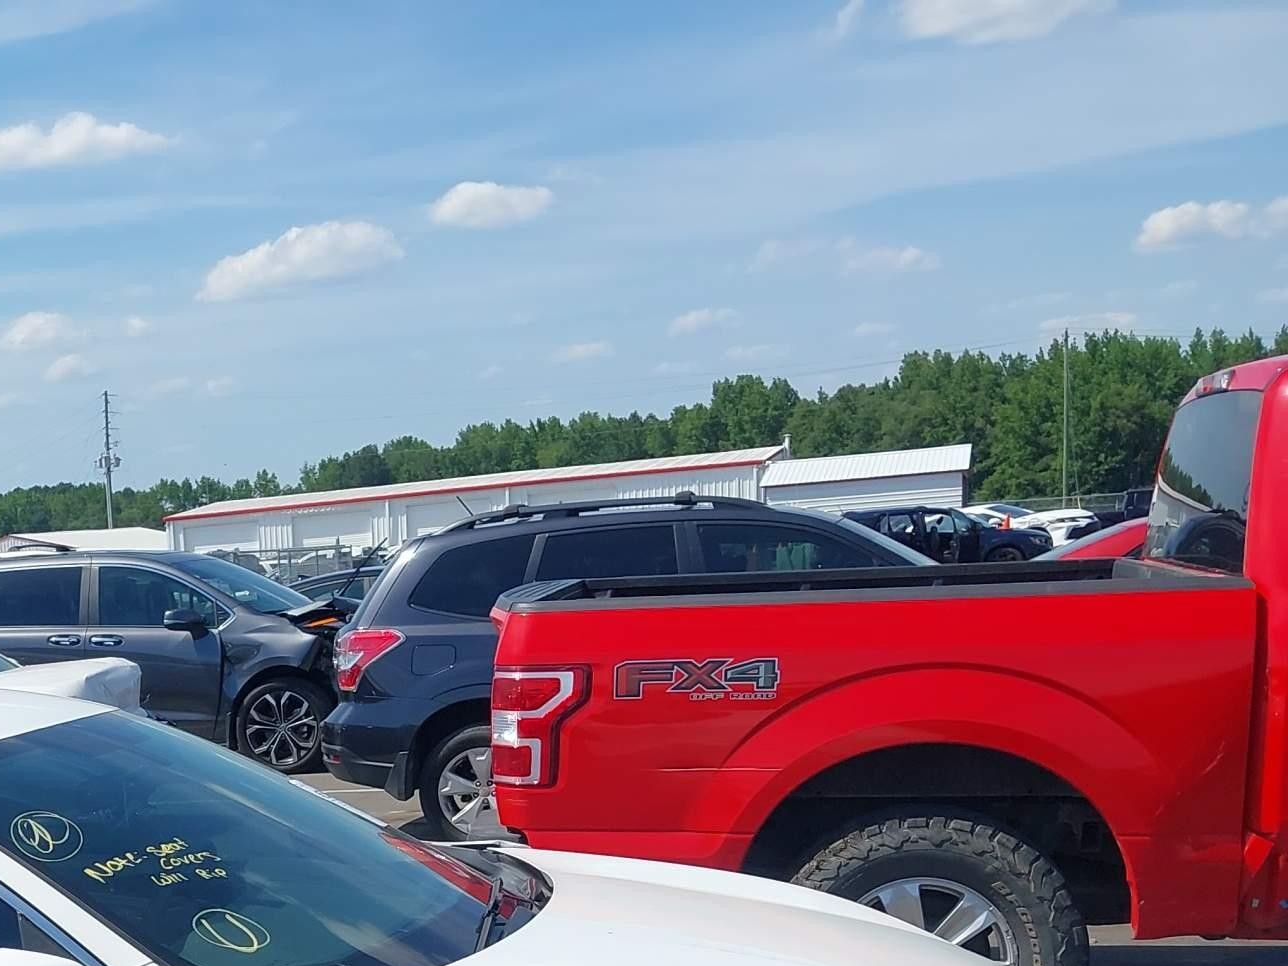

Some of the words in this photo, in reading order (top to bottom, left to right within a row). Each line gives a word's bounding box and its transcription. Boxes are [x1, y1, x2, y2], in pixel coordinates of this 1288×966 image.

[613, 657, 781, 700] FX4
[688, 692, 724, 701] OFF
[729, 692, 777, 701] ROAD
